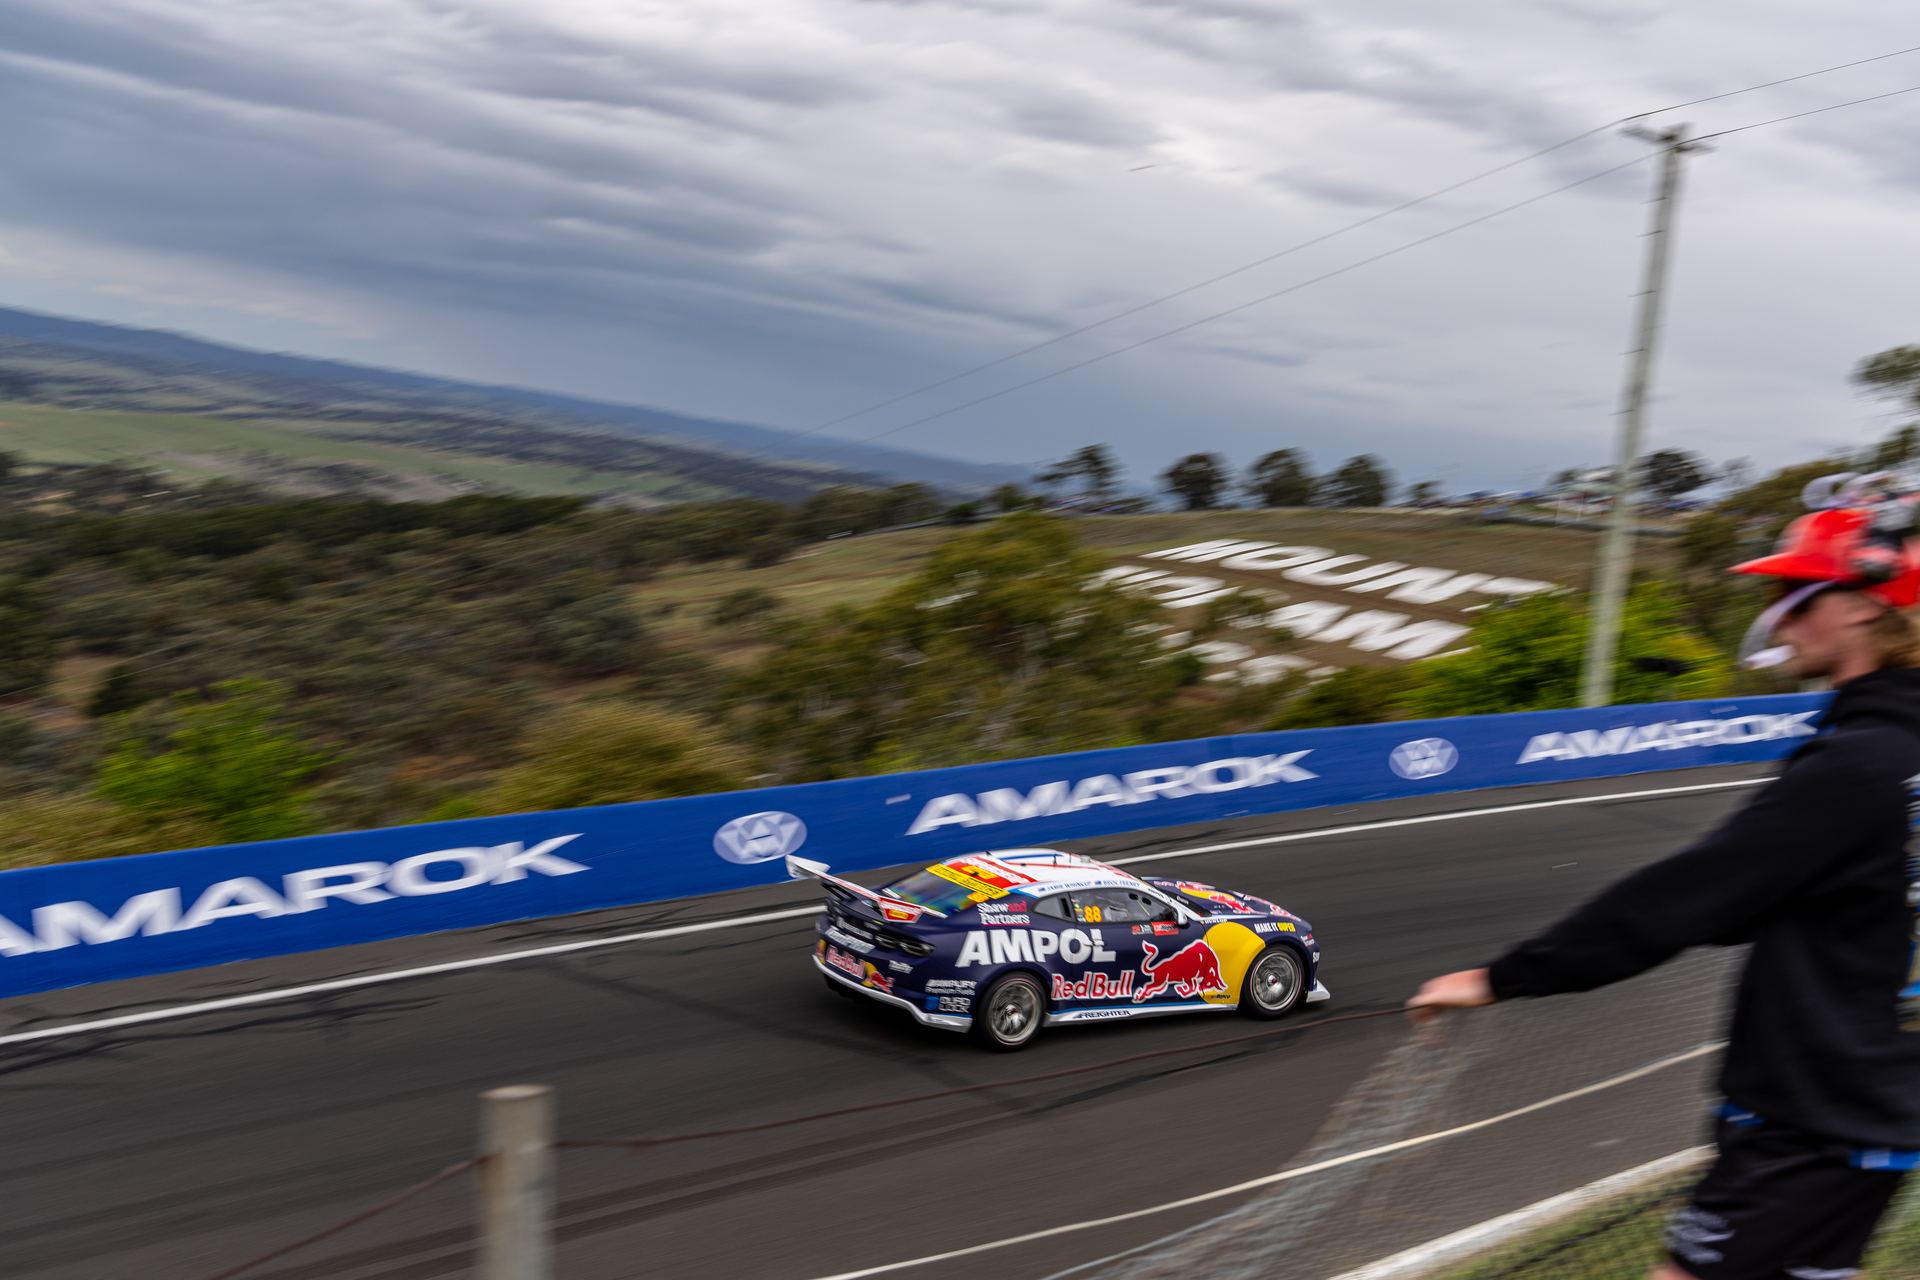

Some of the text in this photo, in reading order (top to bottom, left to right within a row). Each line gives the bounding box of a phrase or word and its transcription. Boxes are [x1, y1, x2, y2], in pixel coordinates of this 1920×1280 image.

[1516, 709, 1822, 765] AMAROK
[904, 749, 1321, 836] AMAROK
[979, 912, 1031, 925] Partners
[1083, 905, 1102, 923] 88
[1254, 922, 1272, 934] MAKE
[955, 928, 1117, 968] AMPOL
[1051, 969, 1135, 1000] Red Bull
